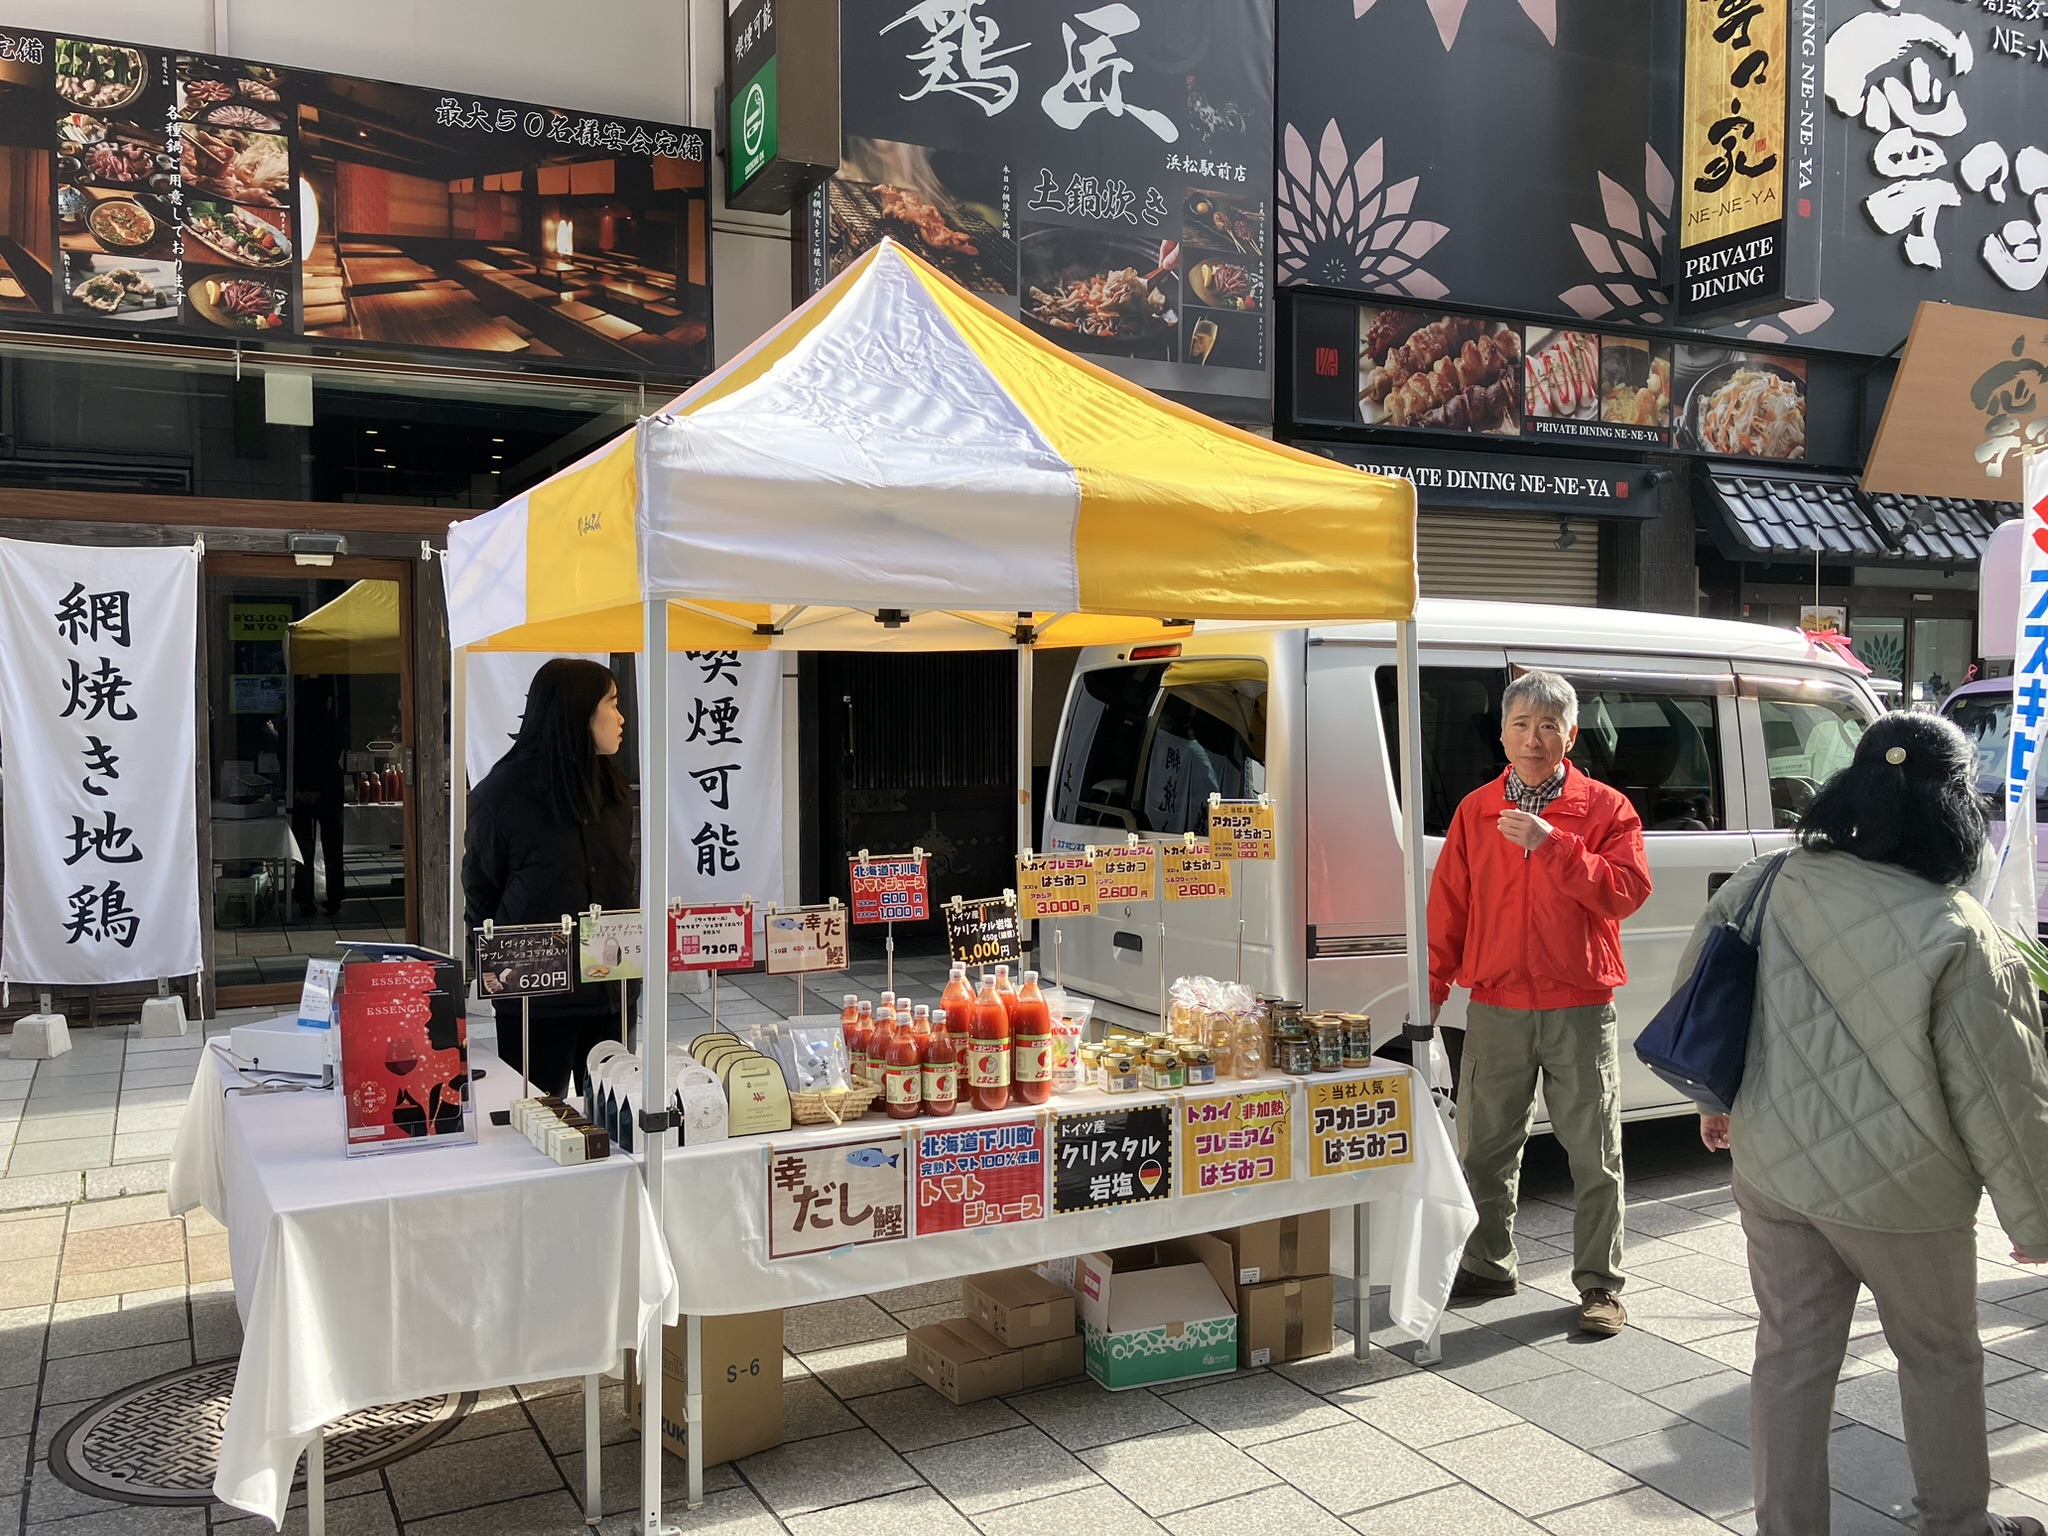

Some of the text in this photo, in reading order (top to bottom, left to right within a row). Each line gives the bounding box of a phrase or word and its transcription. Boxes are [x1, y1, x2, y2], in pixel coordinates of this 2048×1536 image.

[734, 2, 773, 64] 喫煙可能
[1798, 62, 1815, 190] NE-NE-YA
[758, 149, 765, 163] OK
[1166, 153, 1247, 182] 浜松駅前店
[164, 104, 186, 306] 各種鍋ご用意しております
[1027, 167, 1168, 226] 土鍋炊き
[1687, 187, 1776, 227] NE-NE-YA
[812, 184, 822, 292] の網焼きをご堪能くだ
[1685, 236, 1774, 279] PRIVATE
[1690, 265, 1766, 302] DINING
[1536, 421, 1659, 442] PRIVATE DINING NE-NE-YA
[1446, 469, 1516, 492] DINING
[1519, 474, 1611, 498] NE-NE-YA
[54, 581, 143, 949] 網焼き地鶏
[685, 651, 743, 877] 喫煙可能
[1212, 816, 1252, 828] アカシア
[1233, 828, 1272, 840] はちみつ
[1095, 847, 1154, 858] カイプレミアム
[1182, 860, 1222, 872] はちみつ
[854, 863, 921, 878] 北海道下川町
[1041, 874, 1087, 888] はちみつ
[1105, 862, 1147, 874] はちみつ
[854, 877, 926, 893] トマトジュース
[881, 892, 908, 904] 600
[913, 893, 922, 903] 円
[1140, 889, 1148, 898] 円
[1218, 888, 1226, 896] 円
[914, 907, 923, 916] 円
[1082, 904, 1091, 913] 円
[805, 914, 821, 931] 幸
[826, 946, 844, 966] 鰹
[953, 917, 1013, 937] クリスタル岩塩
[702, 943, 738, 955] 730円
[519, 971, 567, 989] 620円
[1331, 1080, 1385, 1100] 当社人気
[1186, 1101, 1233, 1125] トカイ
[1241, 1100, 1285, 1120] 非加熱
[1314, 1100, 1397, 1135] アカシア
[1060, 1119, 1106, 1137] ドイツ産
[1195, 1126, 1275, 1156] プレミアム
[921, 1126, 1035, 1158] 北海道下川町
[1061, 1135, 1162, 1169] クリスタル
[1324, 1132, 1408, 1166] はちみつ
[774, 1156, 808, 1192] 幸
[920, 1150, 1040, 1176] 完熟トマト100%使用
[1200, 1157, 1275, 1187] はちみつ
[920, 1174, 985, 1206] トマト
[1089, 1171, 1134, 1202] 岩塩
[792, 1181, 903, 1238] だし 鰹
[963, 1194, 1044, 1227] ジュース
[726, 1358, 760, 1383] S-6
